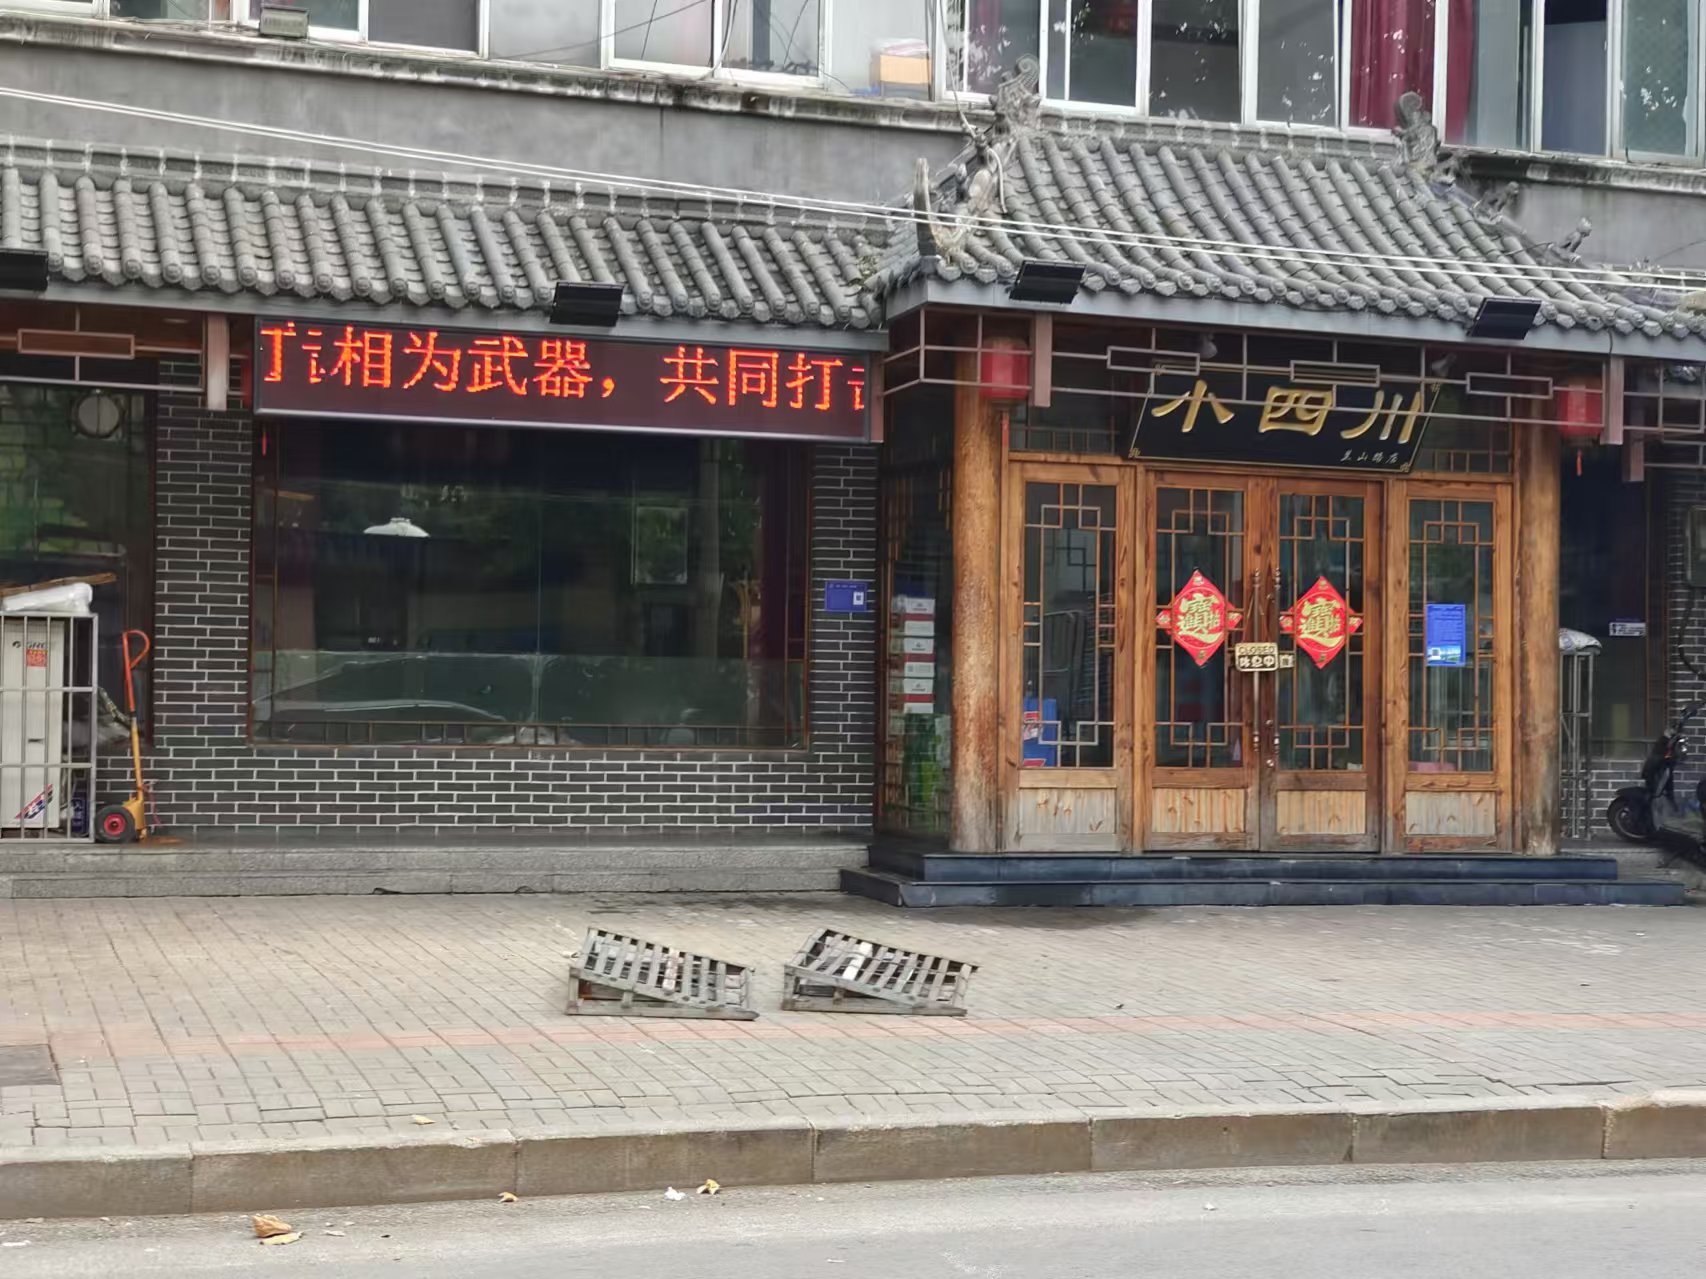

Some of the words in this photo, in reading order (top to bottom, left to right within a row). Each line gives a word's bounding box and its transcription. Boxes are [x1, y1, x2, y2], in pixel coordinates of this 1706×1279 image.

[1151, 379, 1424, 444] 小四川
[1239, 646, 1275, 655] CLOSED
[1239, 655, 1275, 668] 休息中
